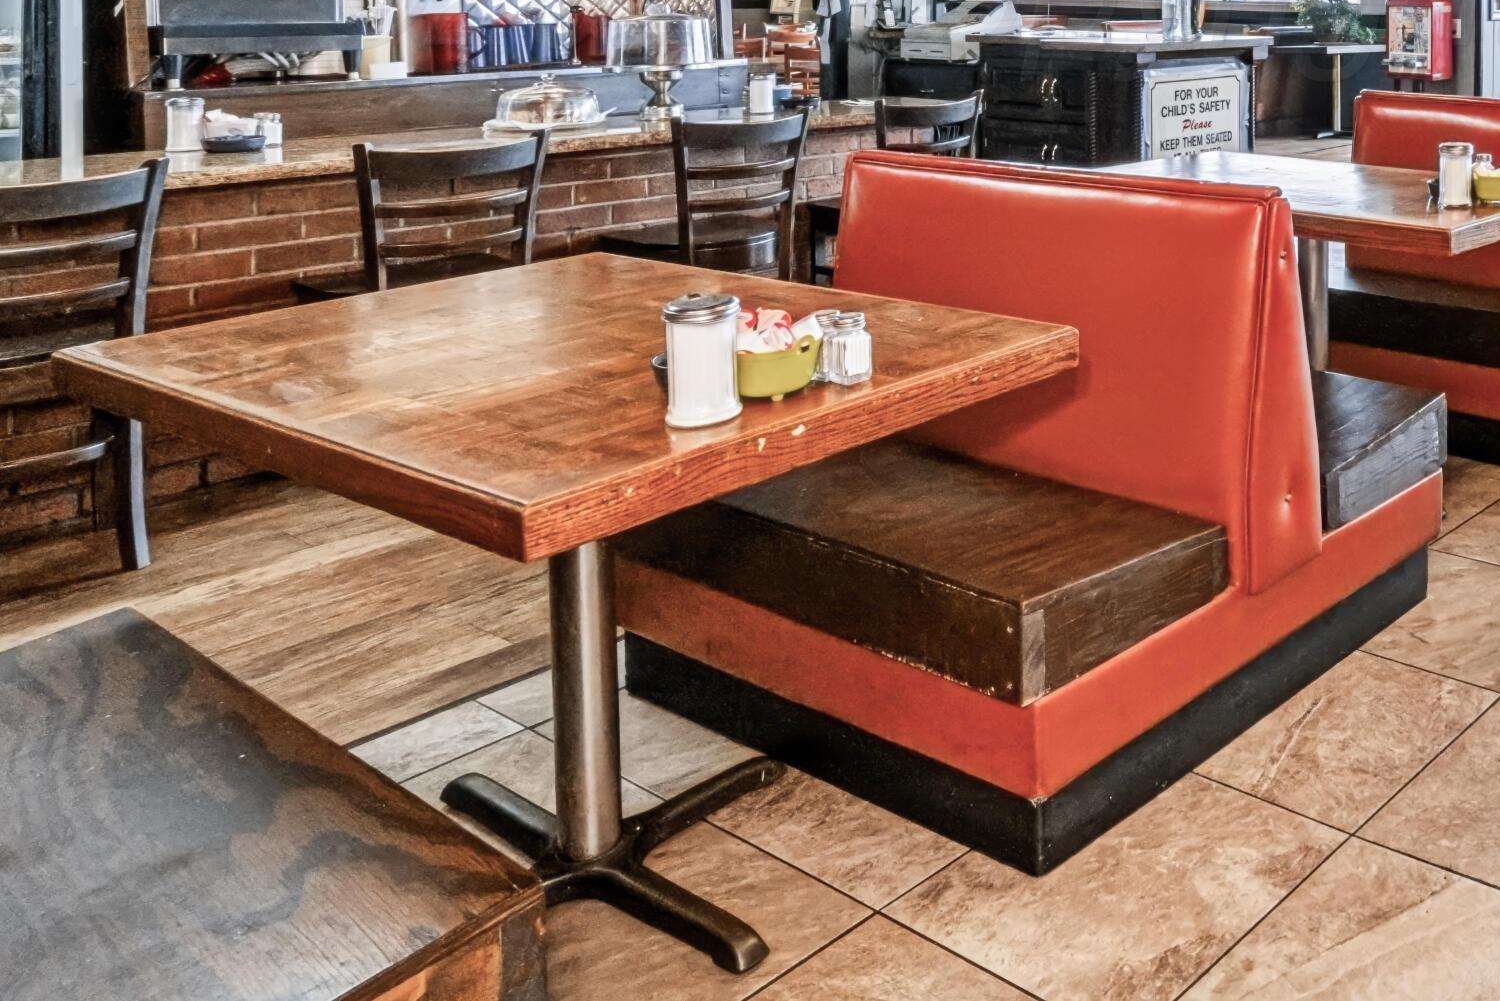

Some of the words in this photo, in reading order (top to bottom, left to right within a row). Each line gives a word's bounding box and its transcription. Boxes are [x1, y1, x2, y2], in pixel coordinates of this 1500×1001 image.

[1174, 89, 1192, 101] FOR
[1195, 86, 1218, 99] YOUR
[1161, 103, 1195, 118] CHILD'S
[1199, 99, 1231, 113] SAFETY
[1182, 118, 1213, 131] Please
[1160, 138, 1180, 151] KEEP
[1182, 134, 1203, 148] THEM
[1205, 130, 1233, 145] SEATED
